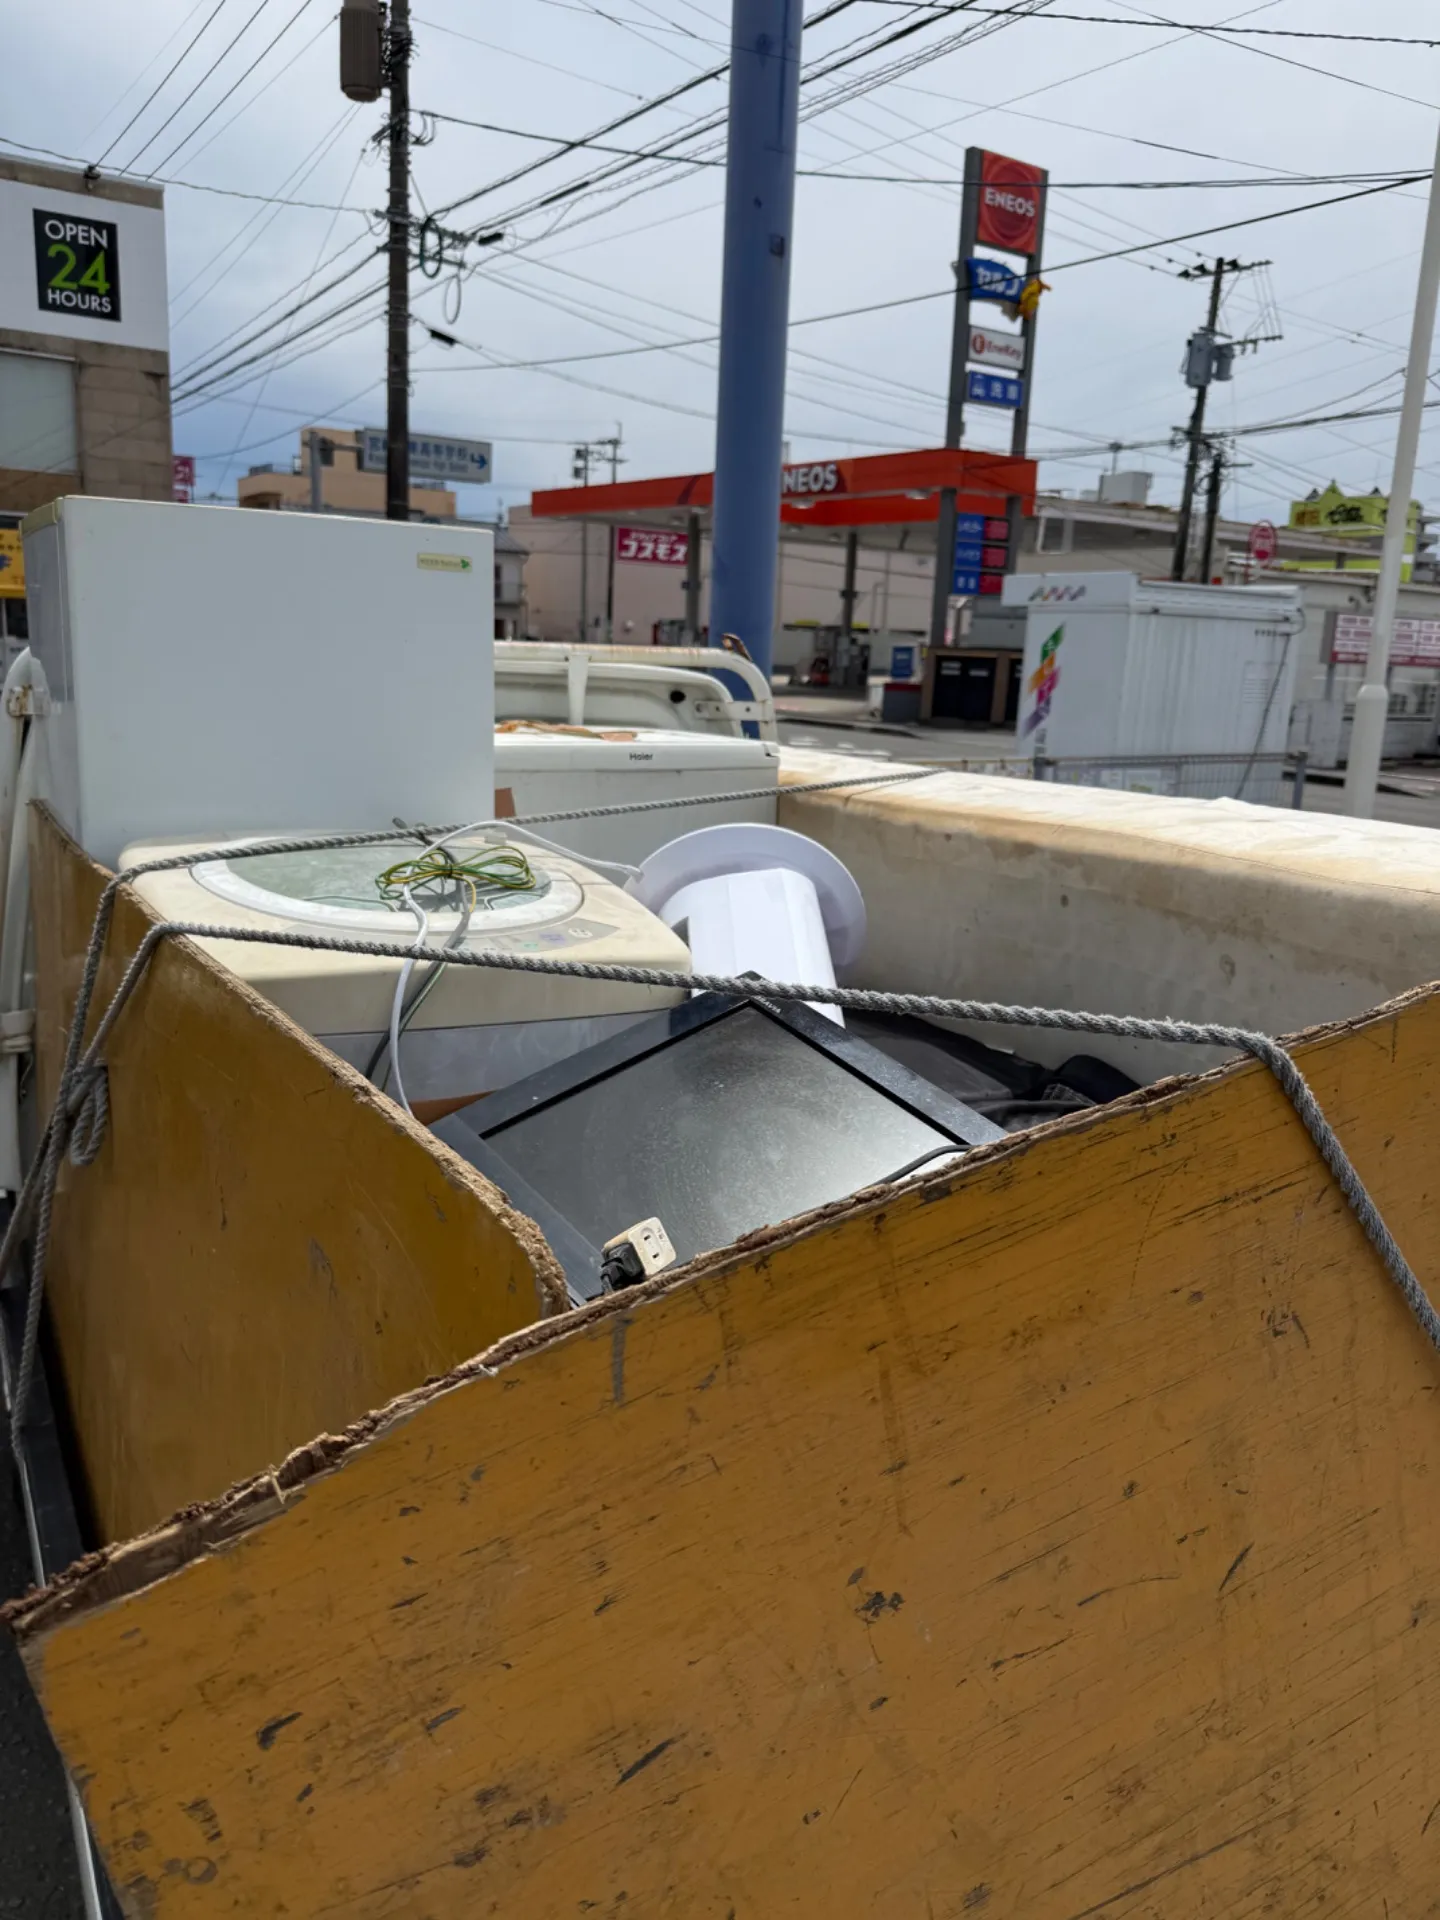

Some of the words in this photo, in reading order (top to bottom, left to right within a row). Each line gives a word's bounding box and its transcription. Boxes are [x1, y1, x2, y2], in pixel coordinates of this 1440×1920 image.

[984, 186, 1036, 217] ENEOS
[45, 219, 108, 249] OPEN
[47, 243, 111, 295] 24
[47, 289, 112, 314] HOURS
[783, 464, 839, 493] NEOS
[620, 540, 688, 562] コスモス
[629, 752, 653, 761] Haier
